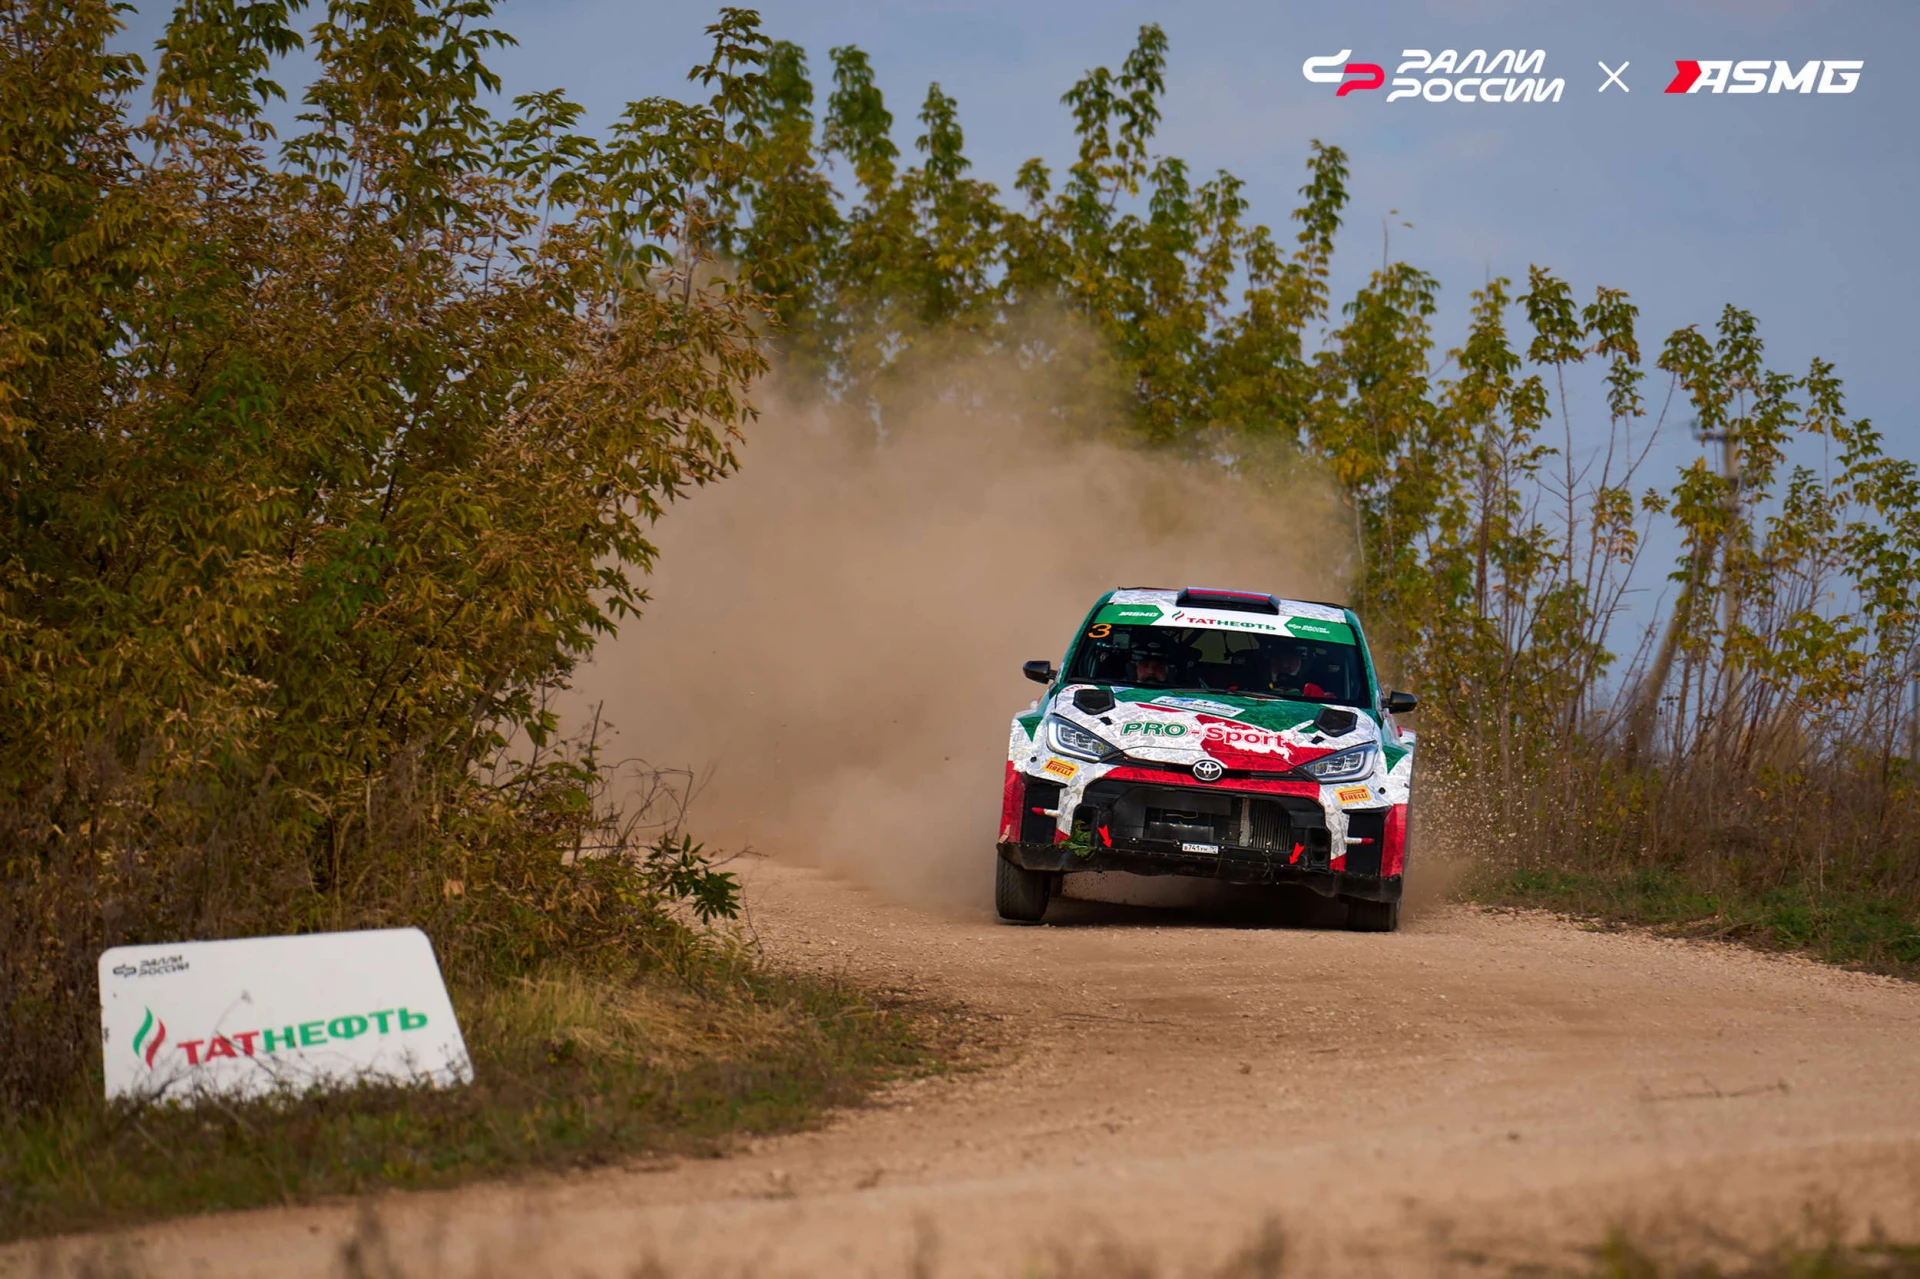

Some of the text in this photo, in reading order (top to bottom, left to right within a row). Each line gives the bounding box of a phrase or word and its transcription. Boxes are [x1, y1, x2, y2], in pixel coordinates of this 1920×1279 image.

[1088, 623, 1112, 638] 3
[1186, 617, 1277, 631] ТАТНЕФТЬ
[1046, 760, 1075, 776] PIRELLI
[1339, 788, 1366, 801] PIRELLI
[177, 1008, 428, 1066] ТАТНЕФТЬ
